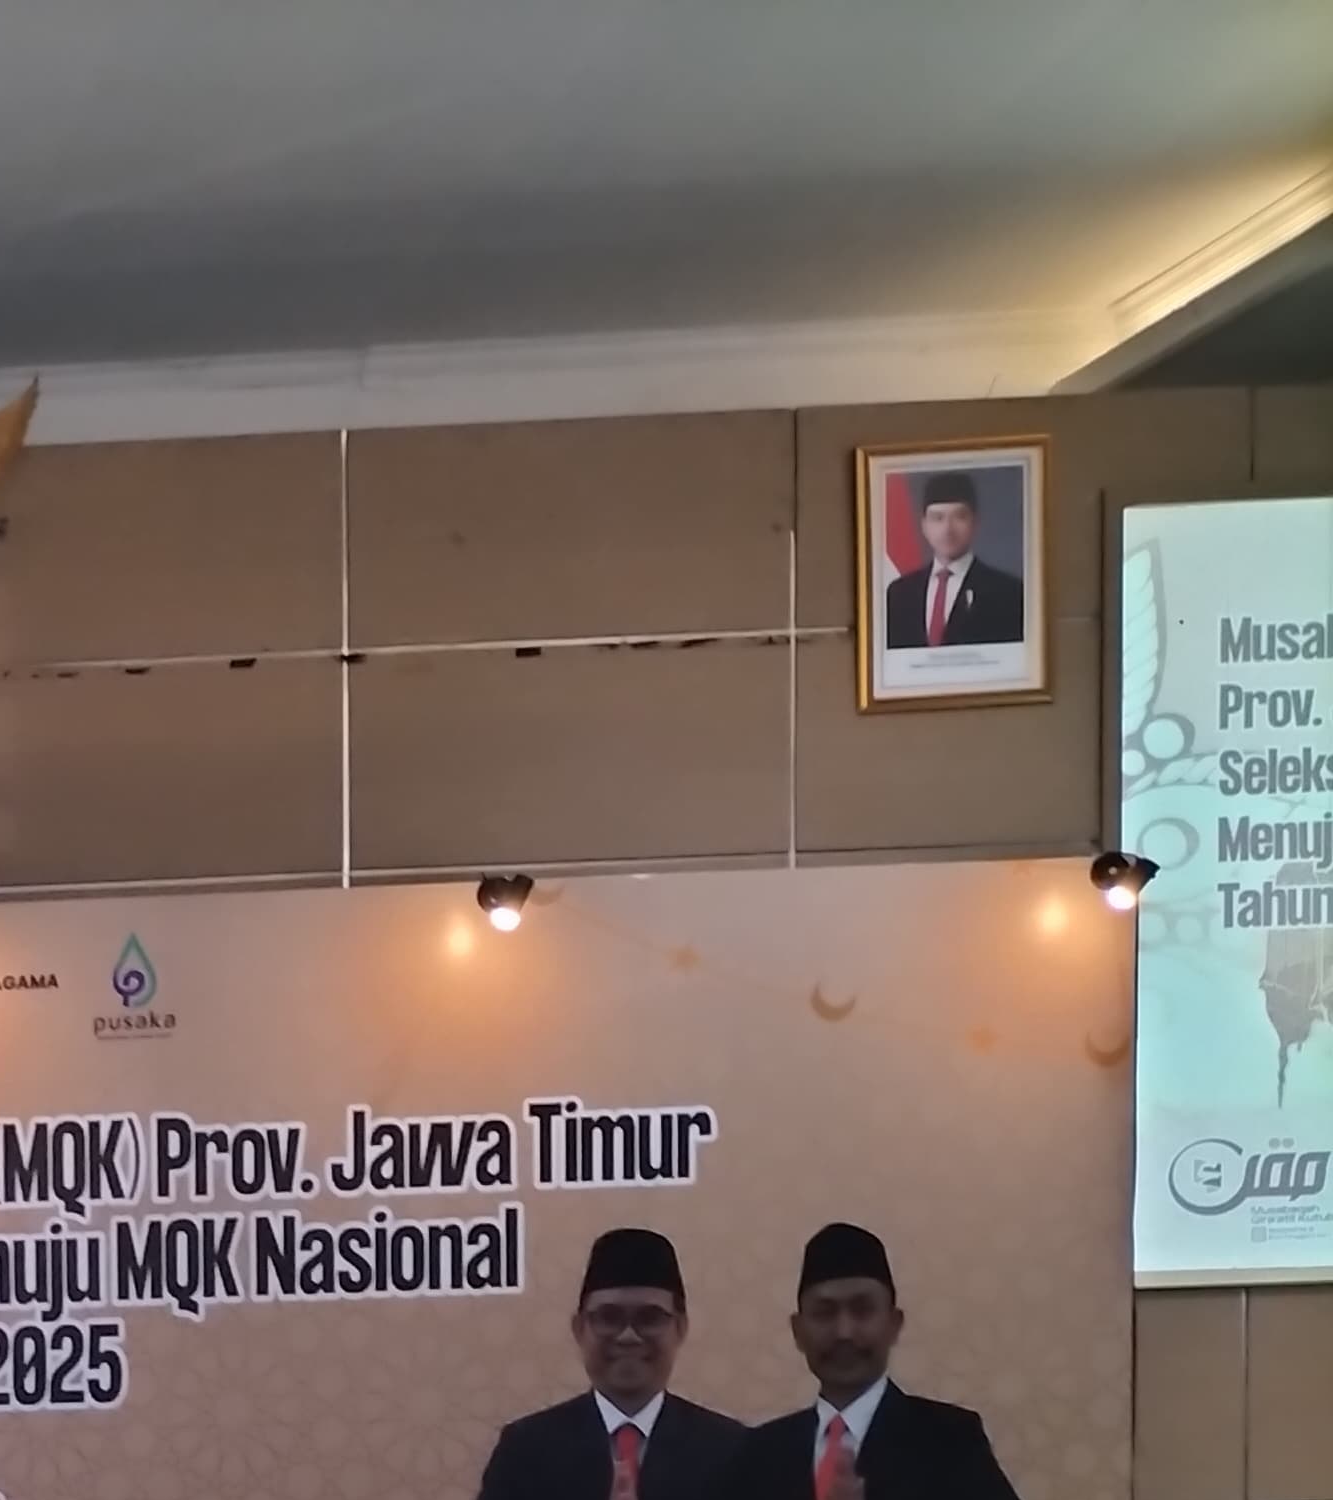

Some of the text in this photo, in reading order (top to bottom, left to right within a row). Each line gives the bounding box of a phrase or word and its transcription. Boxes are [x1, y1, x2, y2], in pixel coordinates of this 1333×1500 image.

[1219, 613, 1333, 664] Musa
[1218, 683, 1323, 730] Prov.
[1216, 881, 1333, 929] Tahun
[93, 1010, 176, 1036] pusaka
[156, 1117, 314, 1198] Prov.
[332, 1110, 512, 1192] Jawa
[528, 1101, 712, 1183] Timur
[115, 1217, 241, 1315] MQK
[256, 1207, 520, 1296] Nasional
